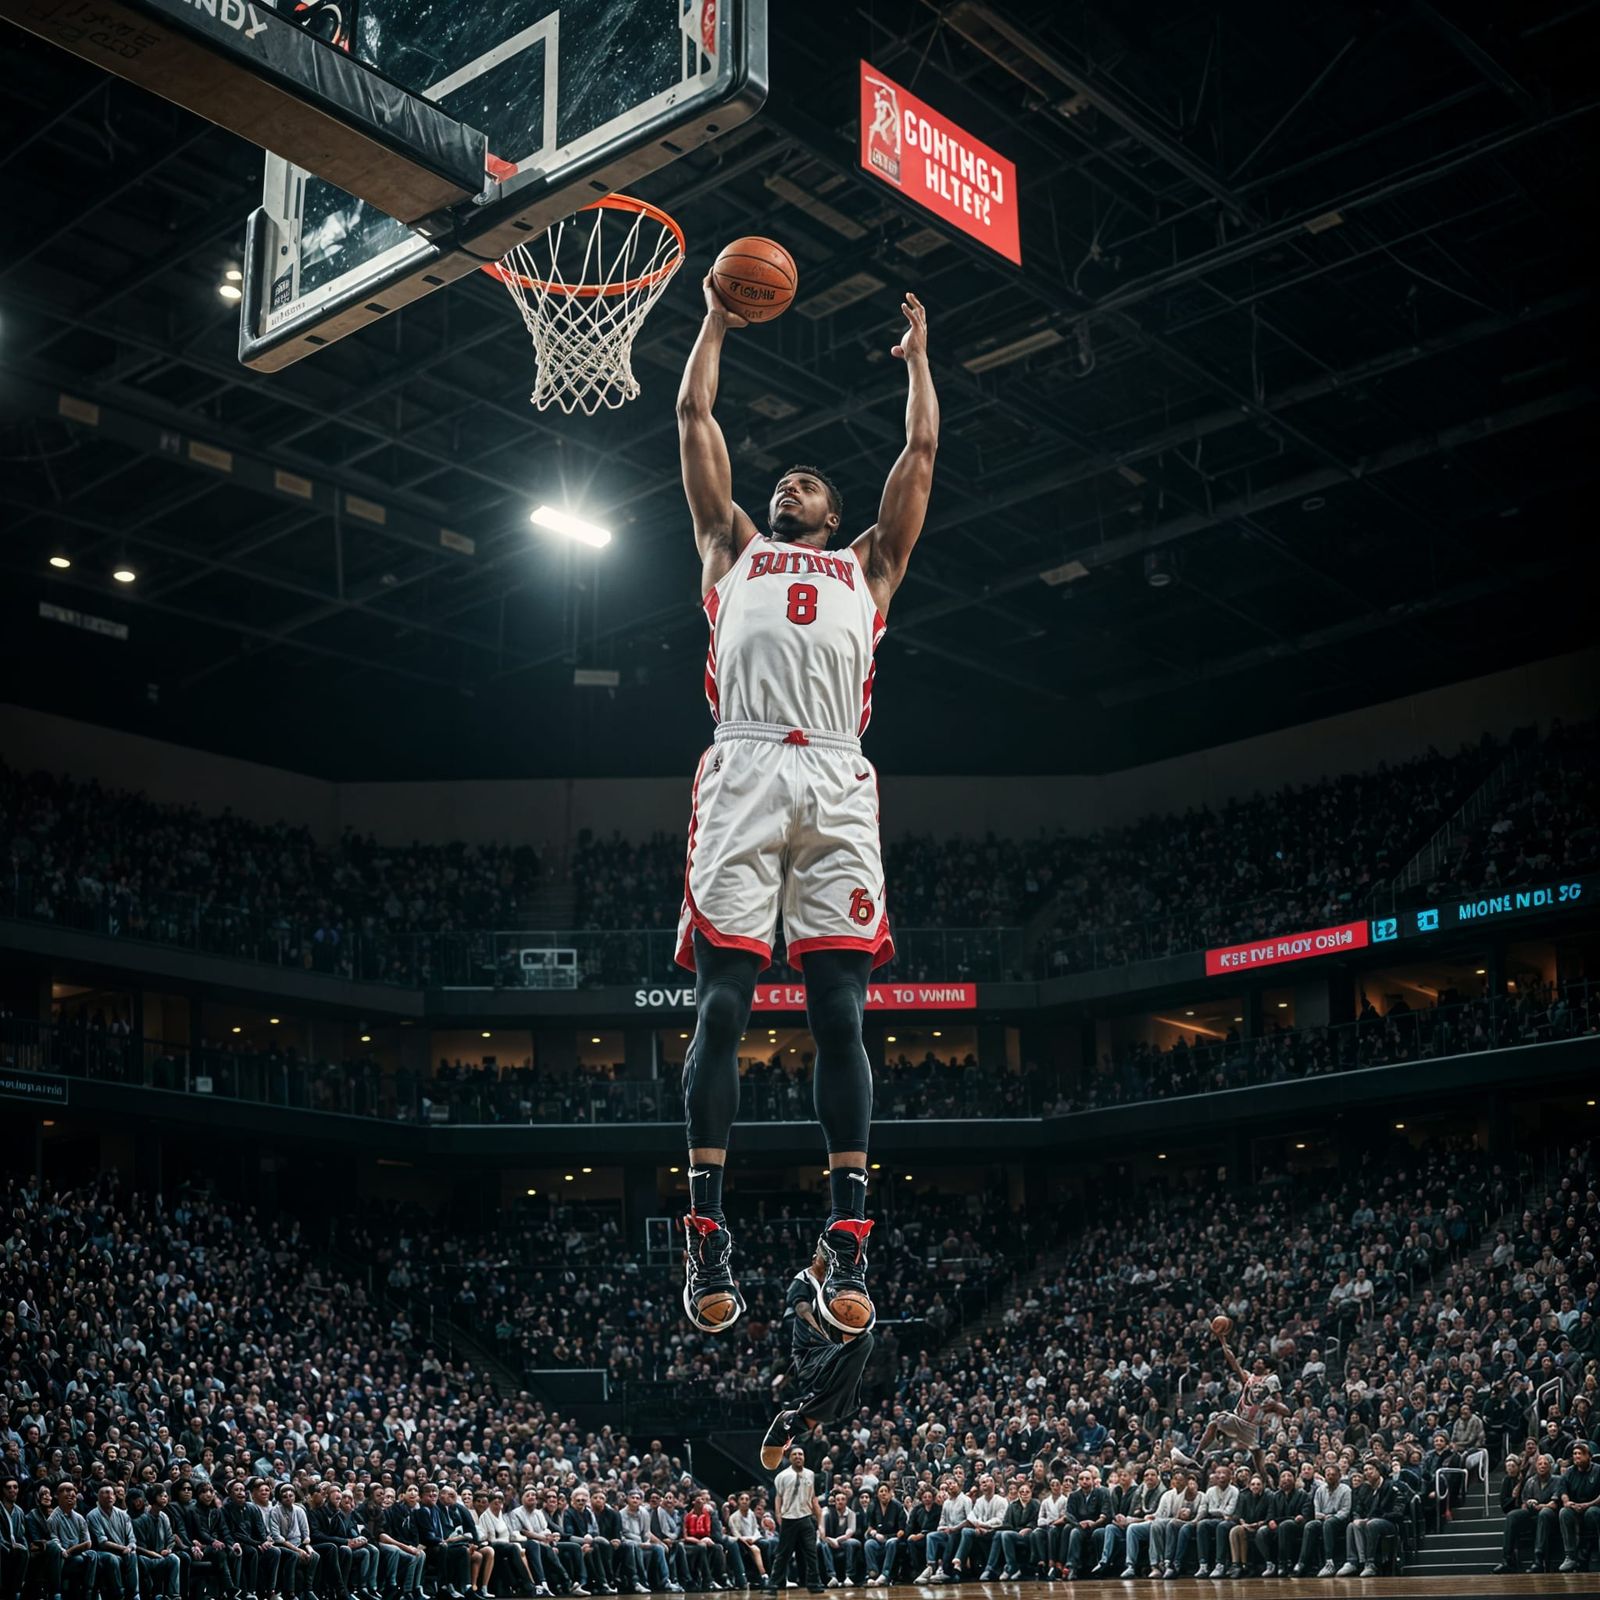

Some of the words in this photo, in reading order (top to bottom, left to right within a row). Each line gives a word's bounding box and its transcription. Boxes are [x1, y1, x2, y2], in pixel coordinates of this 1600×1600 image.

[786, 583, 818, 625] 8
[635, 988, 697, 1007] SOVE
[893, 989, 914, 1003] TO
